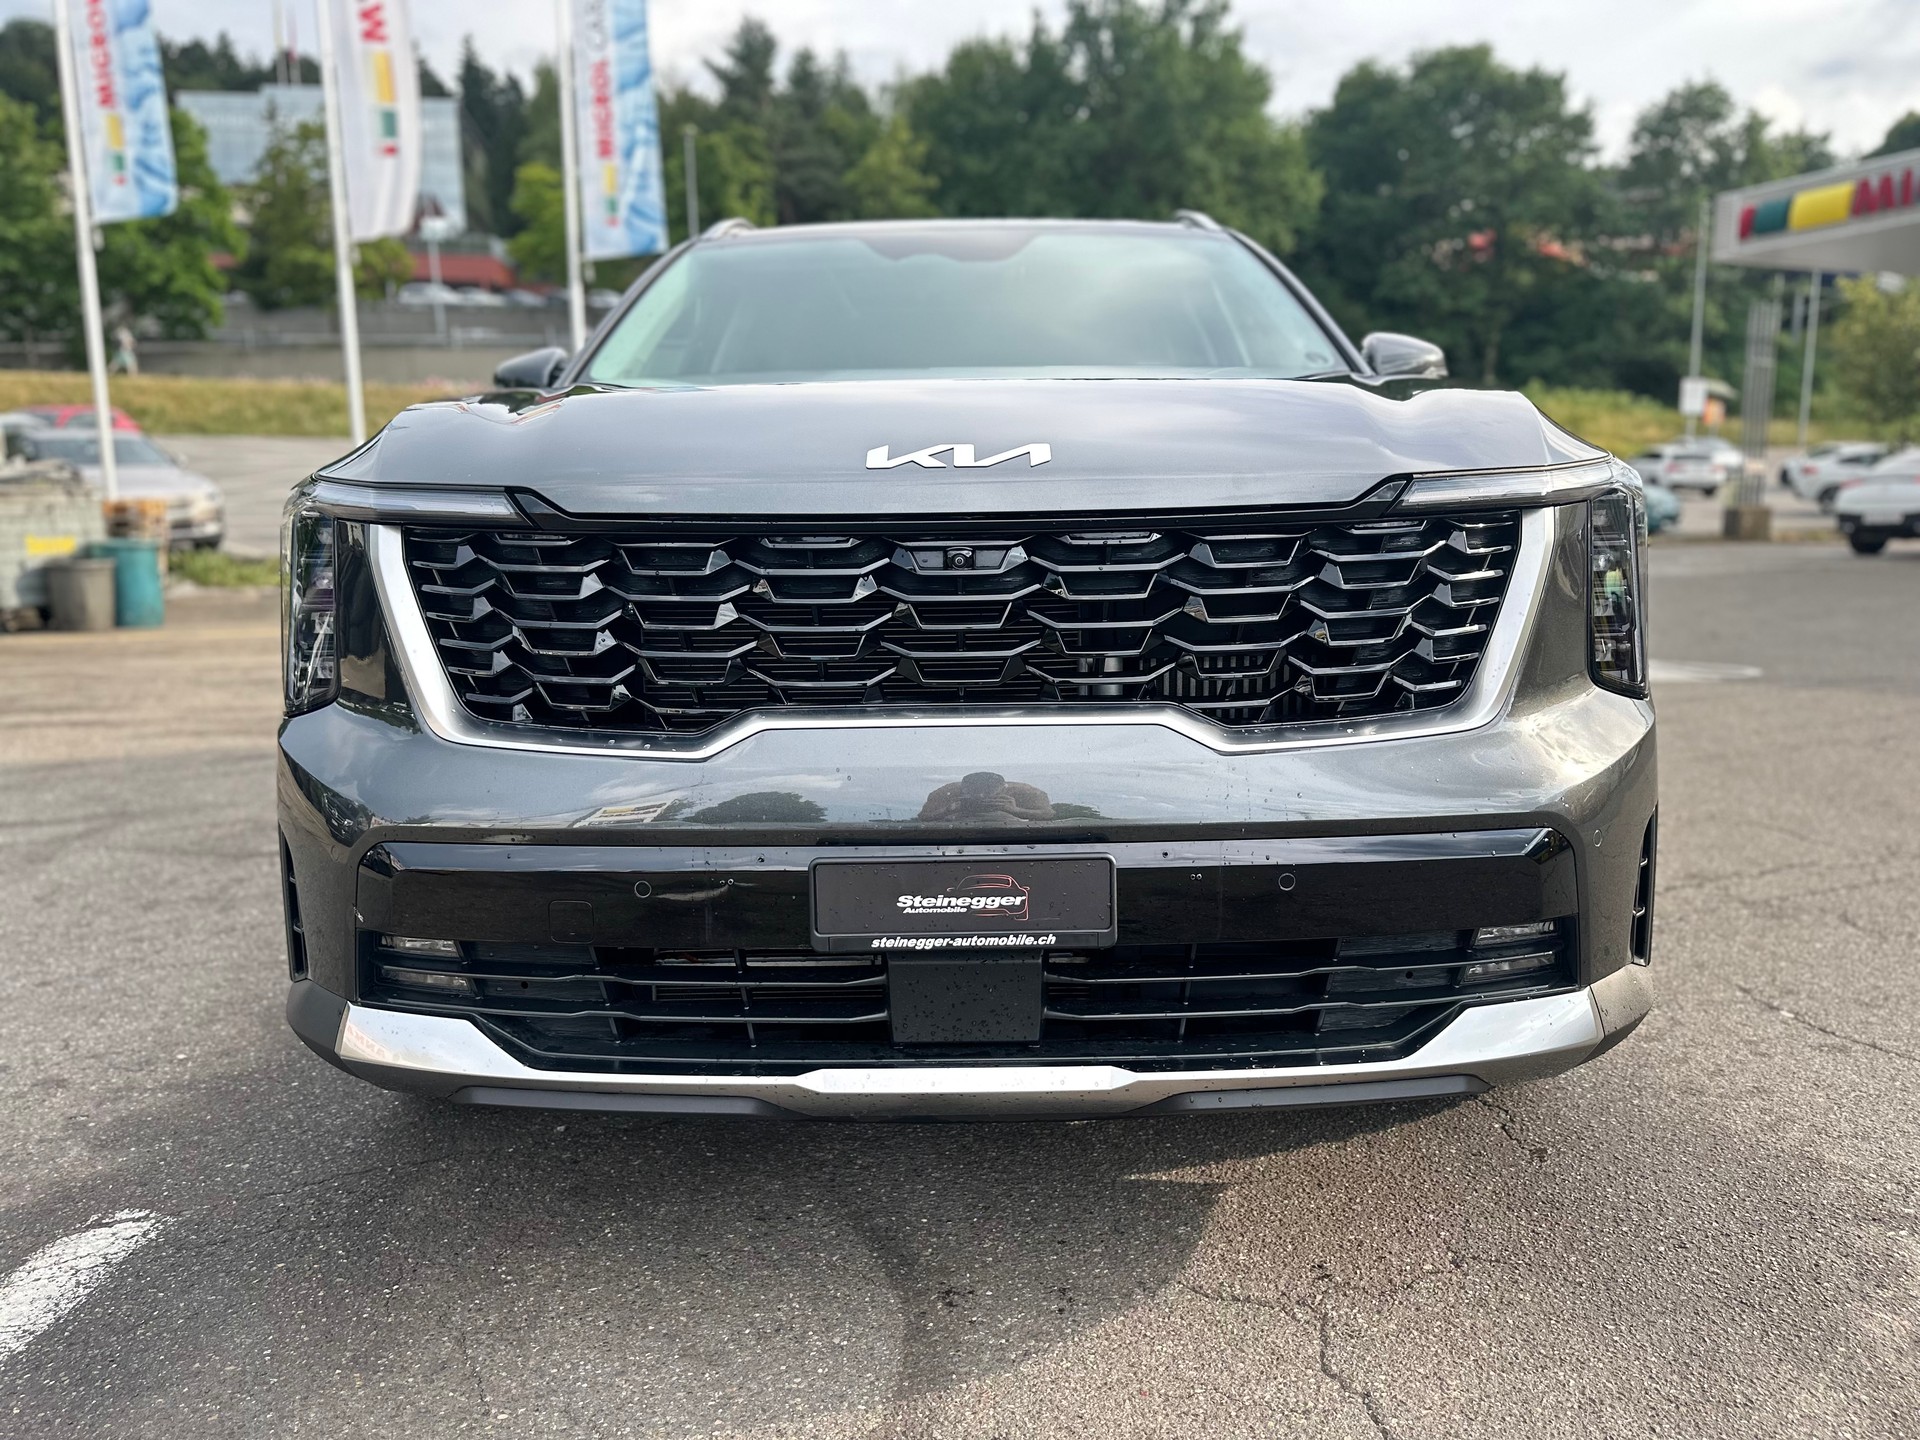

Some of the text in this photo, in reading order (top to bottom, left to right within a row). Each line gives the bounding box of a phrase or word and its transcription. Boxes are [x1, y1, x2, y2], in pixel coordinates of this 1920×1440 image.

[86, 0, 117, 109] MIGRO
[1850, 166, 1920, 218] MI
[896, 894, 1027, 909] Steinegger
[902, 906, 968, 914] Automobile
[871, 934, 1057, 950] steinegger-automobile.ch
